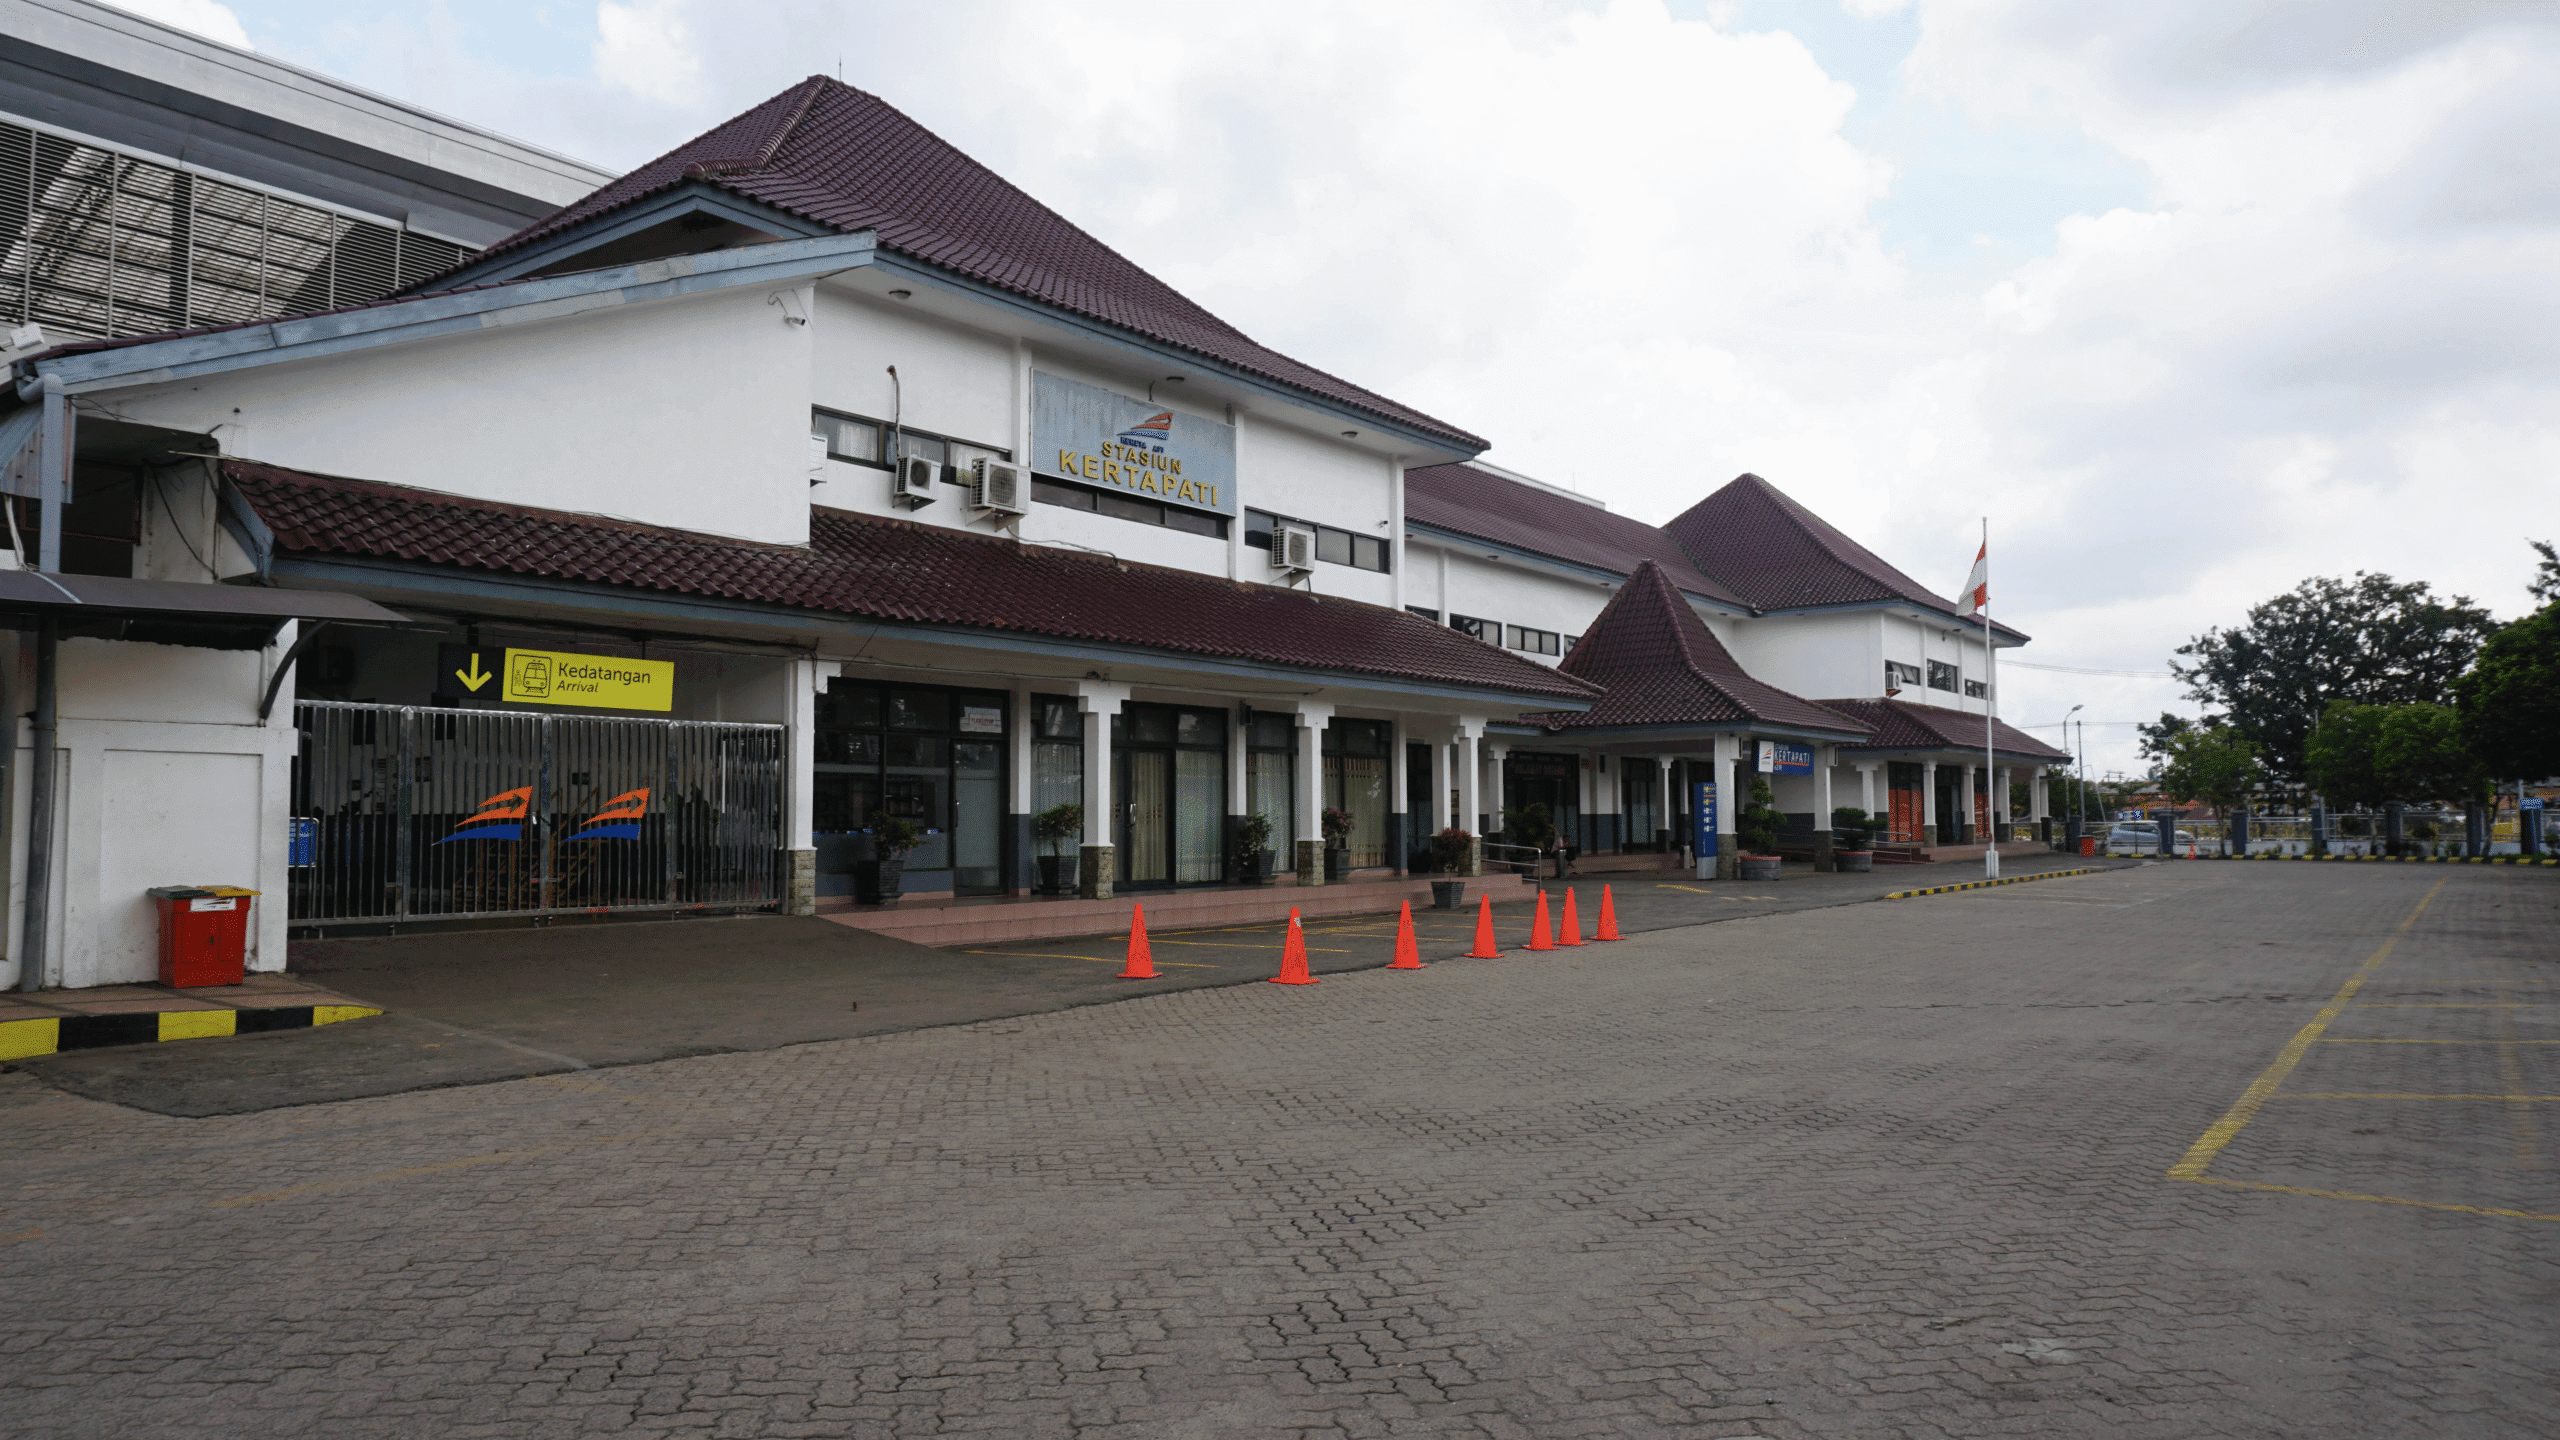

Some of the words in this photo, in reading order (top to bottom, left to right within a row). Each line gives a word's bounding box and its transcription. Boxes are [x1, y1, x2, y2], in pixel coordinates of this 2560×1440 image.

[1102, 441, 1181, 474] STASIUN
[1059, 449, 1218, 506] KERTAPATI
[558, 662, 651, 685] Kedatangan
[556, 680, 599, 693] Arrival
[1774, 750, 1810, 764] KERTAPATI
